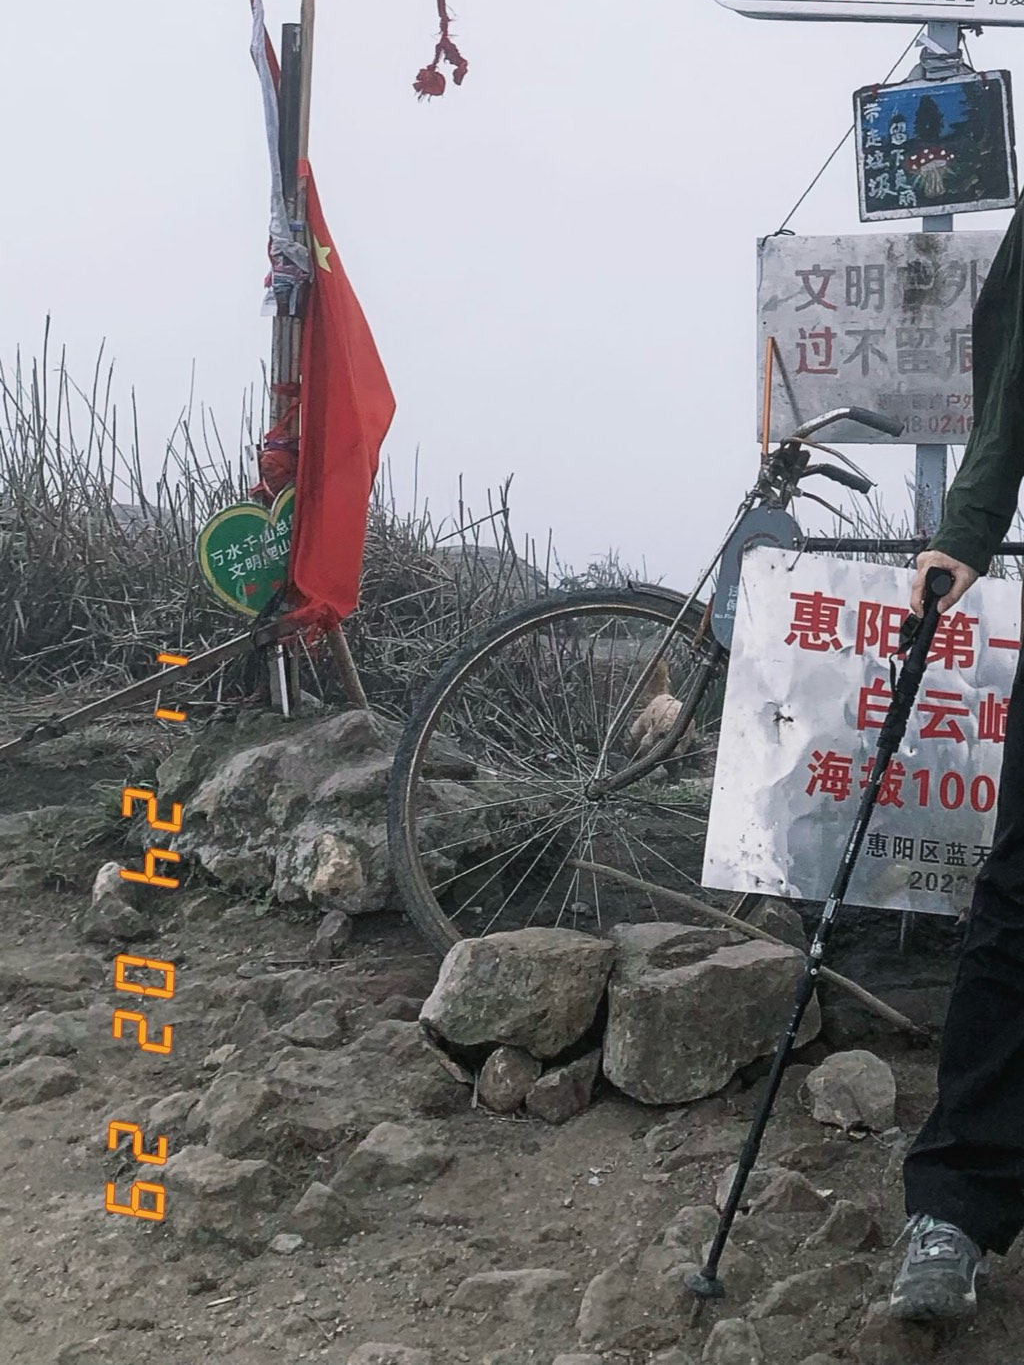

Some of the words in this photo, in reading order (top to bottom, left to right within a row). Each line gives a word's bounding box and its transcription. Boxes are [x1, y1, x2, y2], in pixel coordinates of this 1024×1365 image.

[210, 514, 293, 568] 万水千山总
[784, 590, 1022, 670] 惠阳第一
[805, 749, 997, 813] 海拔100
[865, 832, 993, 867] 惠阳区蓝天
